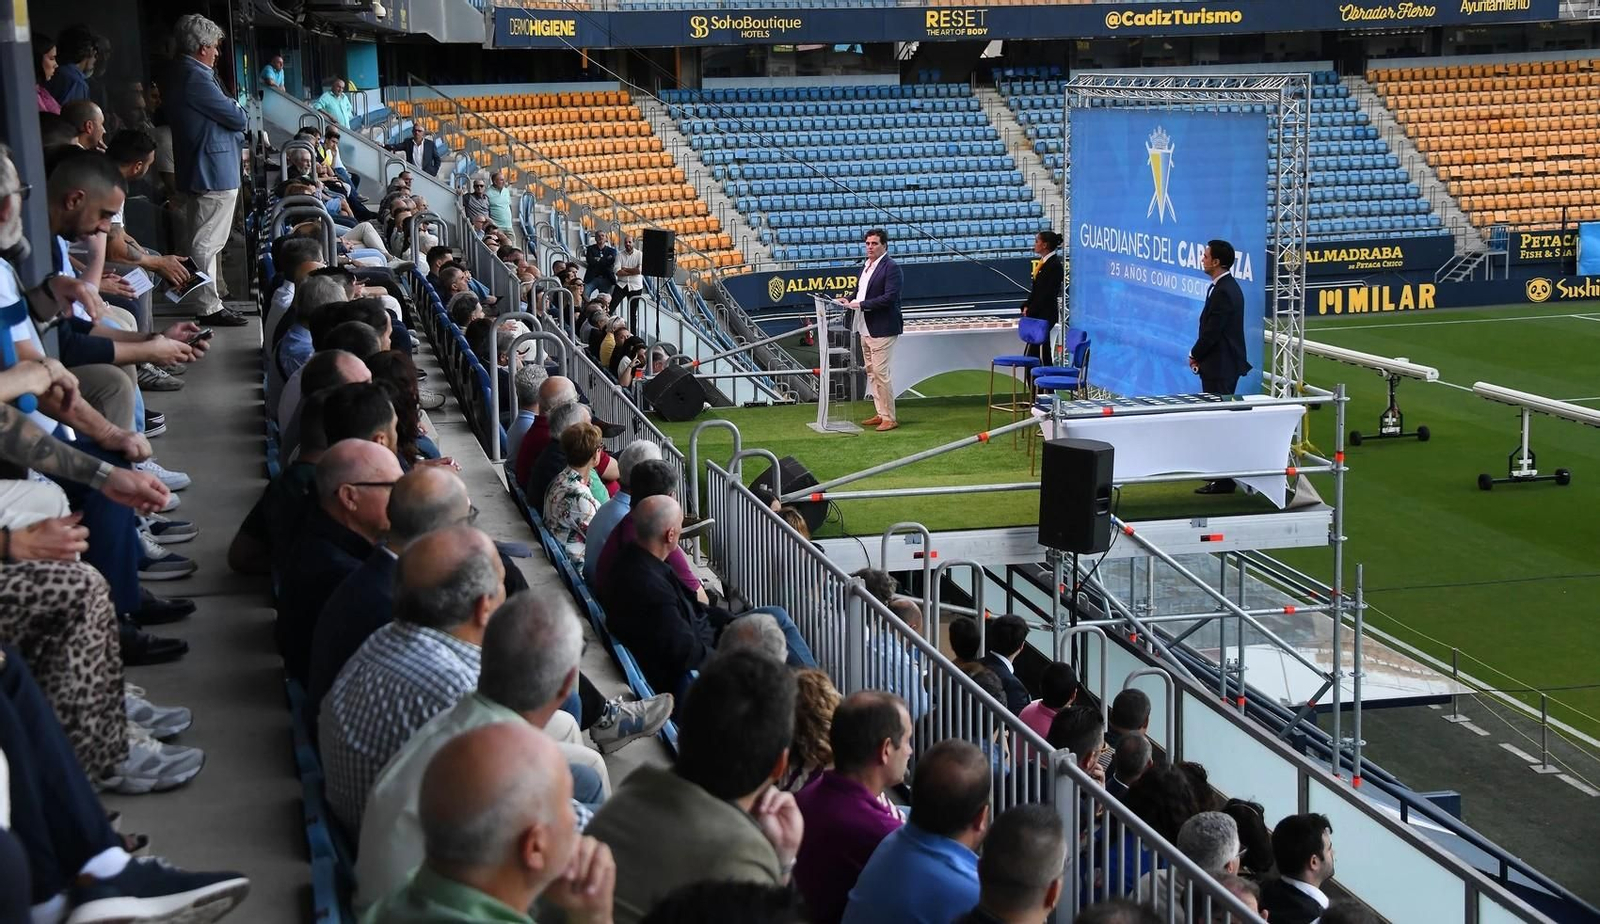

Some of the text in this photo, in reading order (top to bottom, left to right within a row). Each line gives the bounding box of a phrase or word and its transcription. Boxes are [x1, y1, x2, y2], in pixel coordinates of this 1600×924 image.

[1340, 3, 1436, 21] Obrador Fierro
[1460, 0, 1530, 15] Ayuntamiento
[509, 18, 576, 36] DERMOHIGIENE
[711, 15, 802, 33] SohoBoutique
[926, 9, 988, 28] RESET
[1105, 8, 1242, 29] @CadizTurismo
[741, 30, 770, 38] HOTELS
[1080, 223, 1253, 281] GUARDIANES DEL CARZA
[1304, 246, 1404, 263] ALMADRABA
[1520, 250, 1543, 259] FISH
[1544, 249, 1553, 257] &
[1355, 261, 1381, 269] PETACA
[1381, 260, 1403, 268] CHICO
[1110, 262, 1121, 276] 25
[1124, 263, 1147, 282] AÑOS
[1150, 270, 1178, 290] COMO
[1556, 277, 1600, 298] Sushi
[1348, 284, 1436, 313] MILAR
